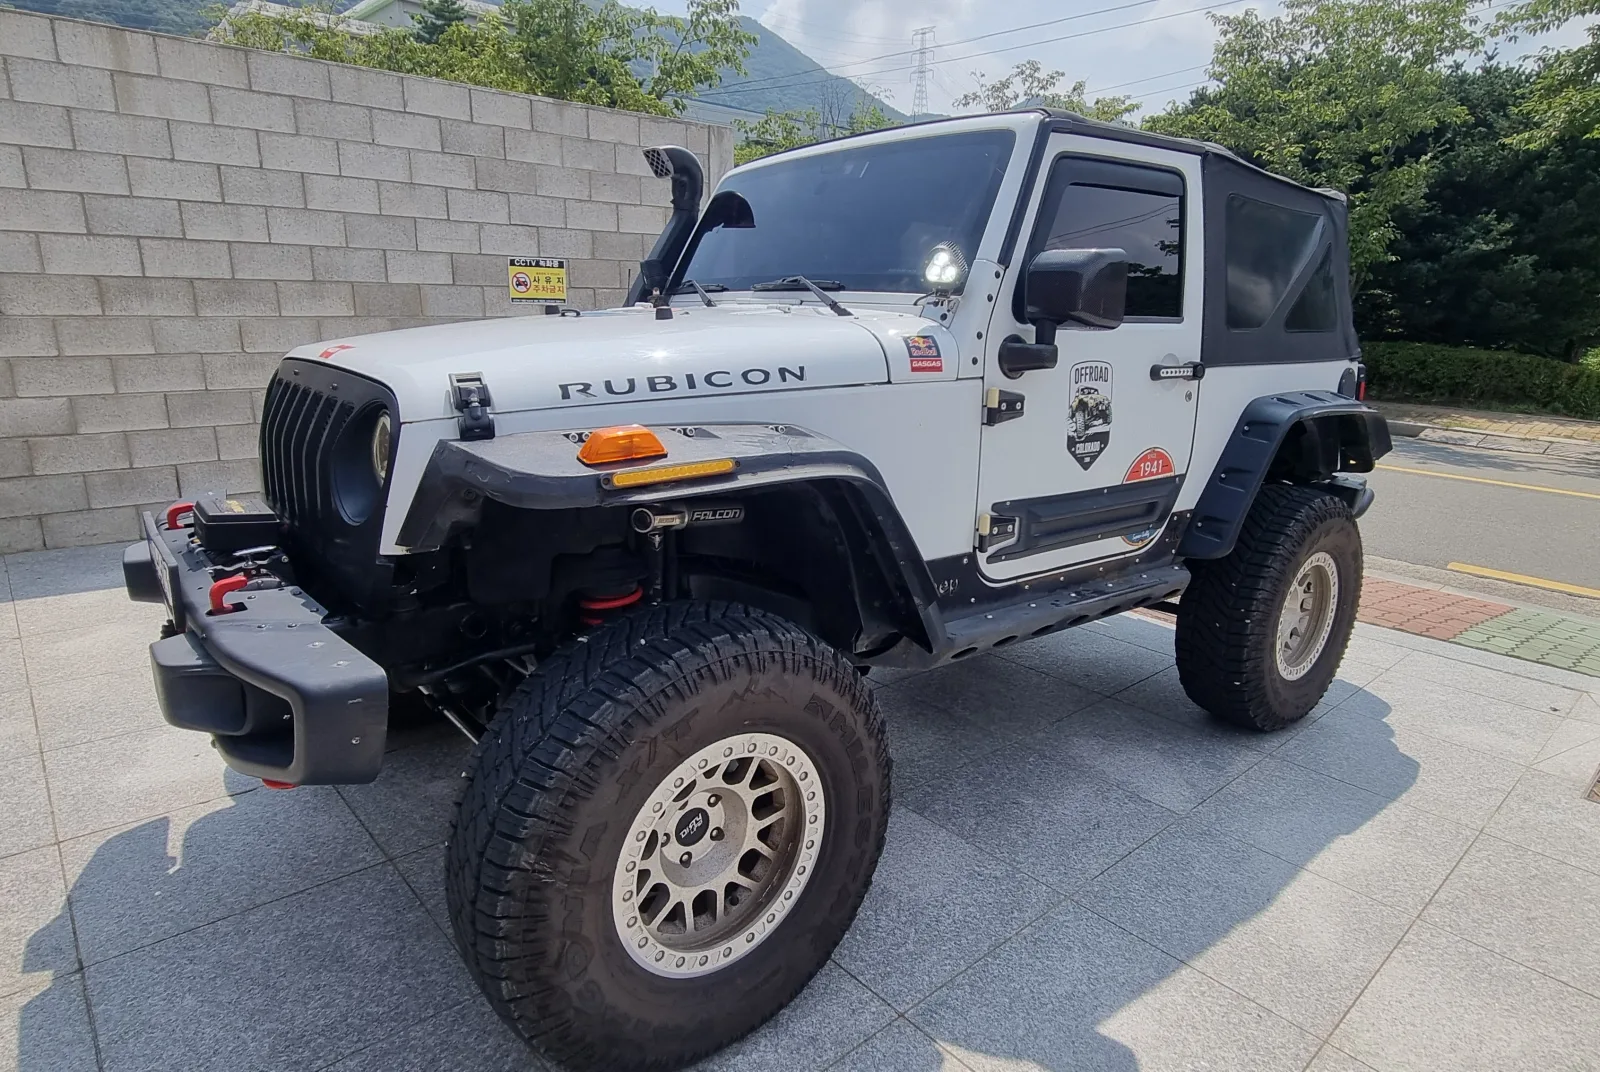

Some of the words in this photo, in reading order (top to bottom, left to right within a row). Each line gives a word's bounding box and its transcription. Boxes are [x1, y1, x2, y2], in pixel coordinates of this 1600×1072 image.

[514, 259, 536, 267] CCTV
[533, 285, 564, 294] 주차금지
[1074, 365, 1109, 385] OFFROAD
[558, 366, 806, 400] RUBICON
[1140, 459, 1163, 477] 1941
[692, 509, 741, 521] FALCON
